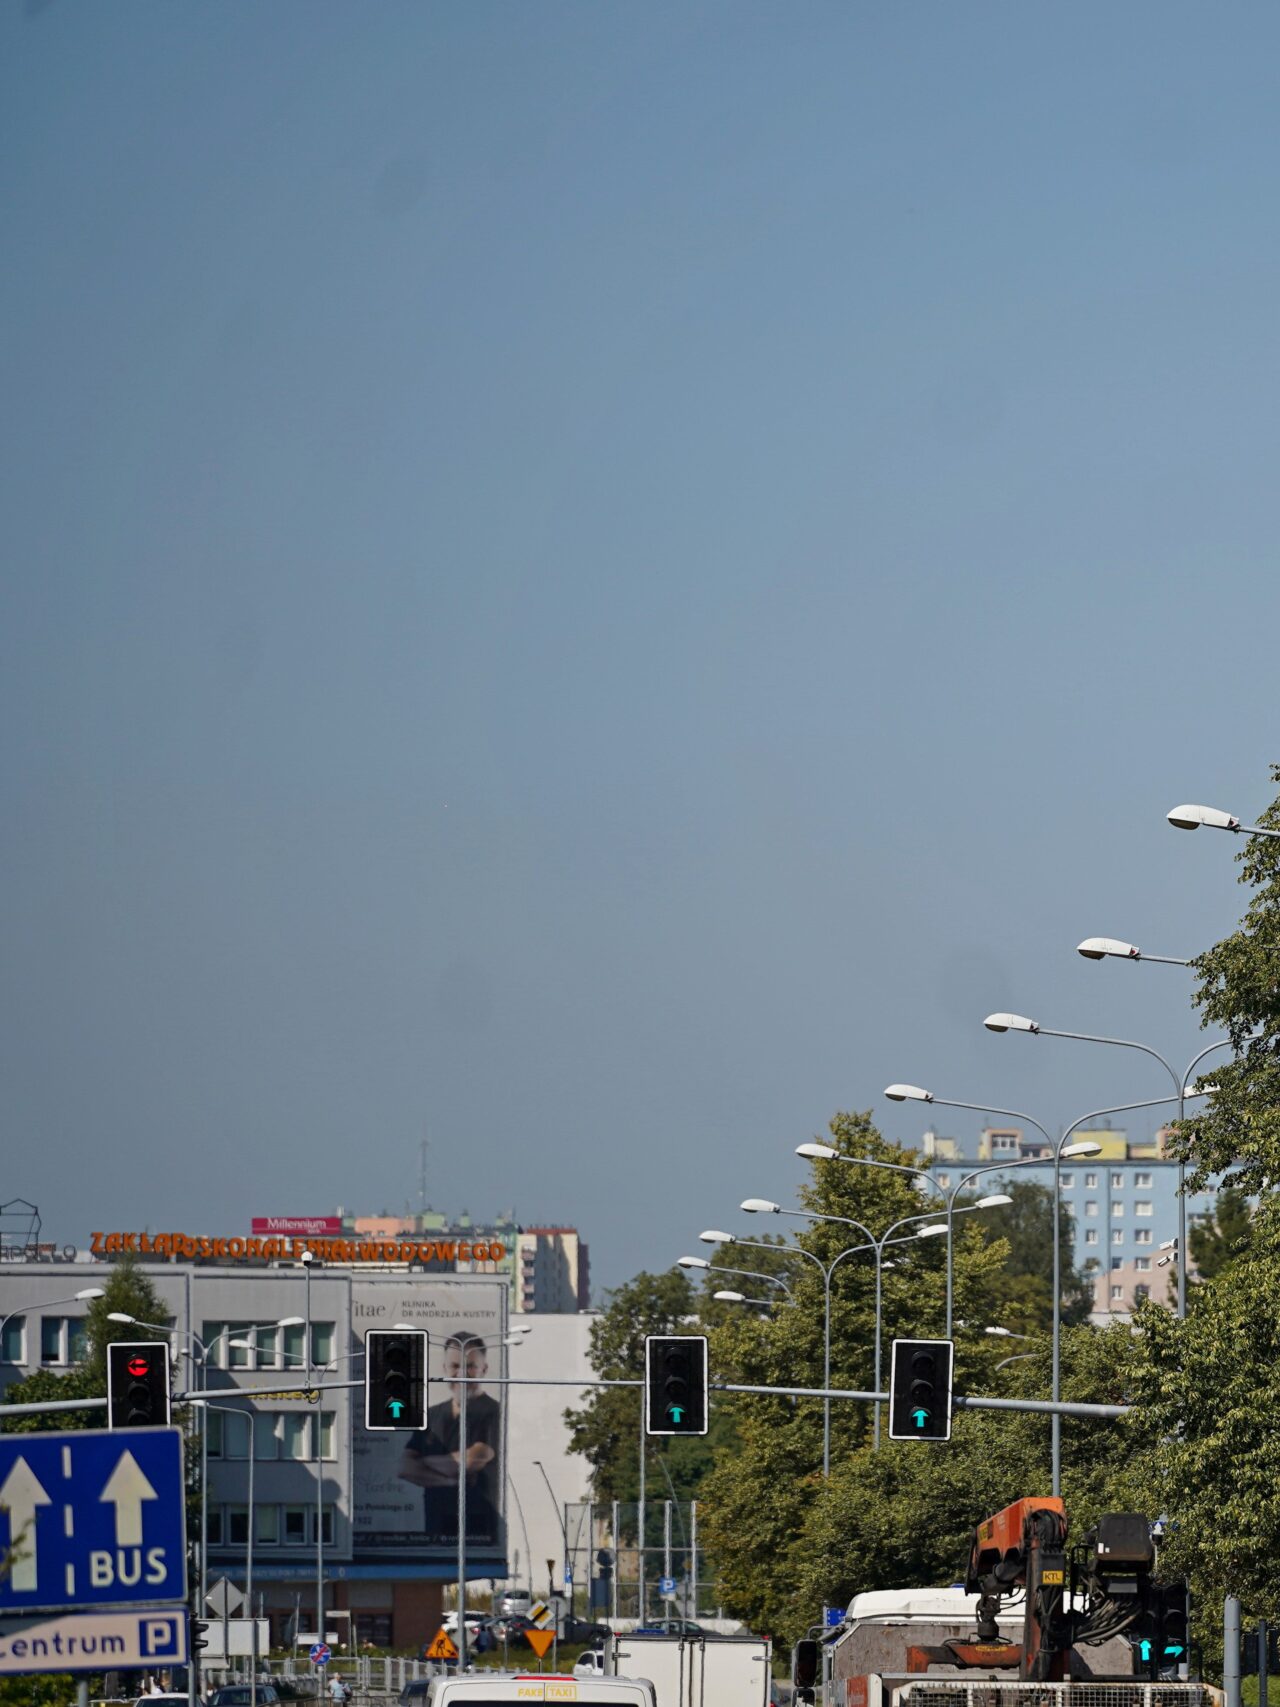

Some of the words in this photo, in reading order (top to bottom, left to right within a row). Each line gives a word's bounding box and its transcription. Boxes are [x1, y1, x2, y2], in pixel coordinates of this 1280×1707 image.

[266, 1217, 327, 1231] Millennium
[180, 1236, 347, 1263] OSKONALENIA
[352, 1300, 386, 1318] itae
[402, 1310, 414, 1319] DR
[417, 1310, 460, 1319] ANDRZEJA
[402, 1301, 436, 1309] KLINIKA
[90, 1548, 167, 1588] BUS
[1044, 1573, 1061, 1581] KTL
[147, 1621, 172, 1655] P
[518, 1688, 543, 1698] FAKE
[550, 1688, 573, 1698] TAXI
